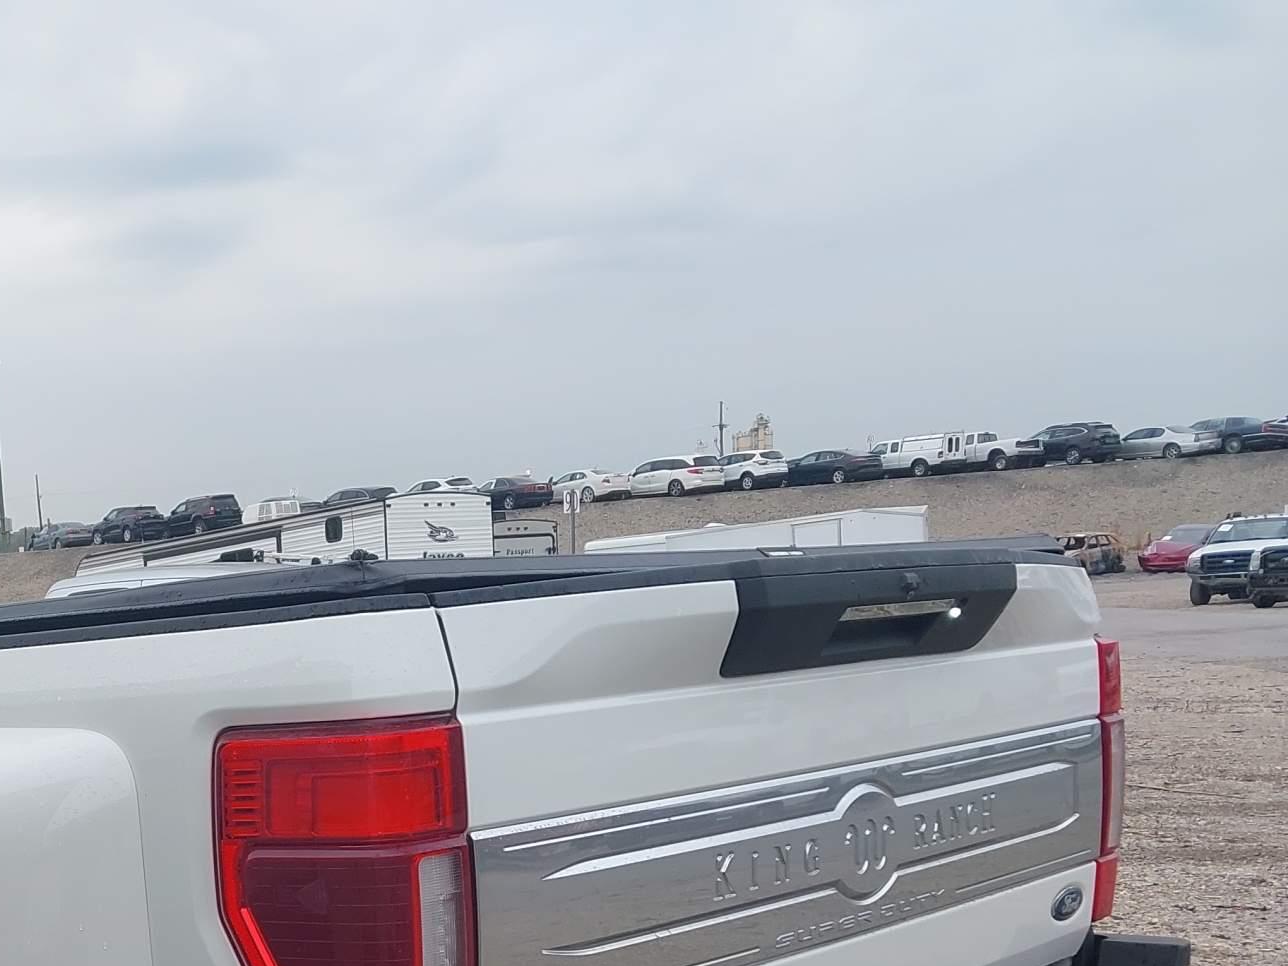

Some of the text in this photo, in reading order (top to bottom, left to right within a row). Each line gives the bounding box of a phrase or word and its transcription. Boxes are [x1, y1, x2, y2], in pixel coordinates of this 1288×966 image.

[714, 792, 997, 901] KING RANCH
[775, 887, 945, 949] SUPER DUTY
